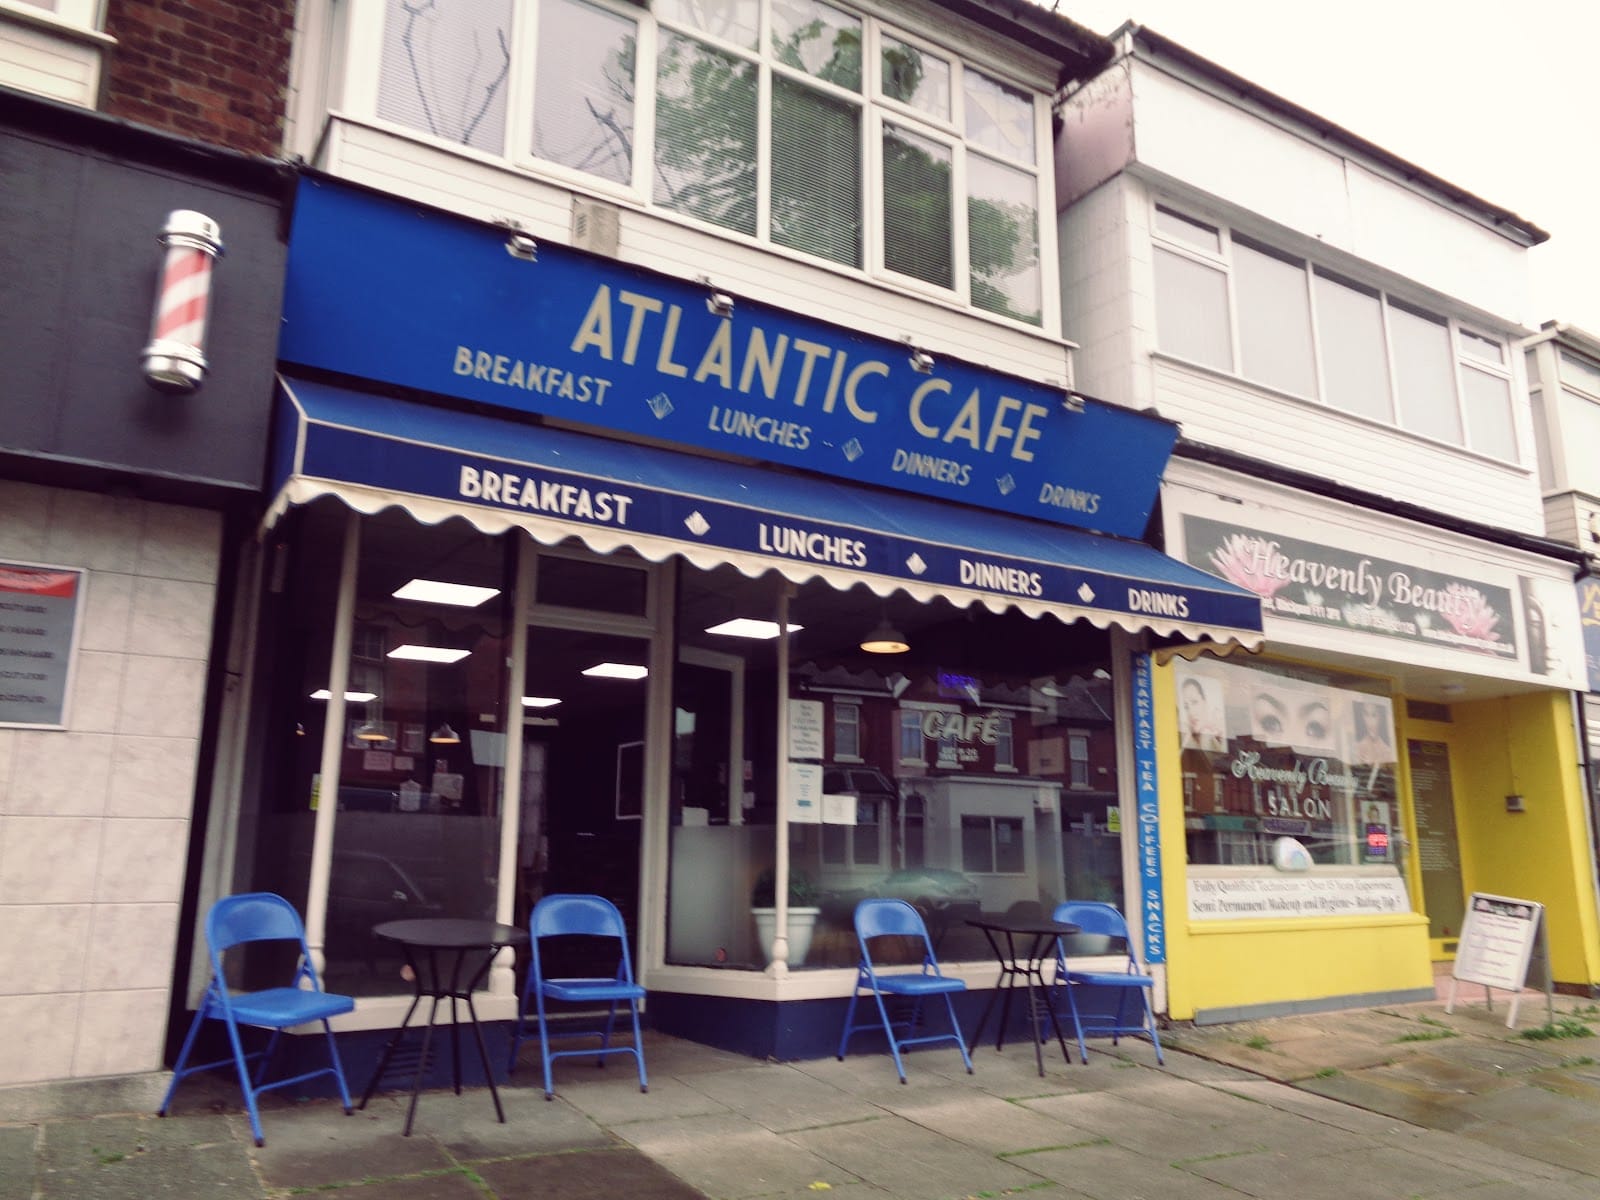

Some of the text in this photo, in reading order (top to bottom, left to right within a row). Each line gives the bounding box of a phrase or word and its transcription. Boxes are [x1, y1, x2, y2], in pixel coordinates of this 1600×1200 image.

[570, 283, 1048, 463] ATLANTIC CAFE
[452, 345, 1101, 514] BREAKFAST LUNCHES DINNERS DRINKS
[459, 465, 1190, 618] BREAKFAST LUNCHES DINNERS DRINKS
[1245, 540, 1383, 610] Heavenly
[1388, 571, 1478, 622] Beauty
[1136, 656, 1151, 749] BREAKFAST
[1140, 760, 1154, 791] TEA
[1268, 790, 1331, 820] SALON
[1140, 803, 1158, 877] COFFEES
[1146, 889, 1162, 955] SNACKS
[1218, 899, 1266, 912] Permanent
